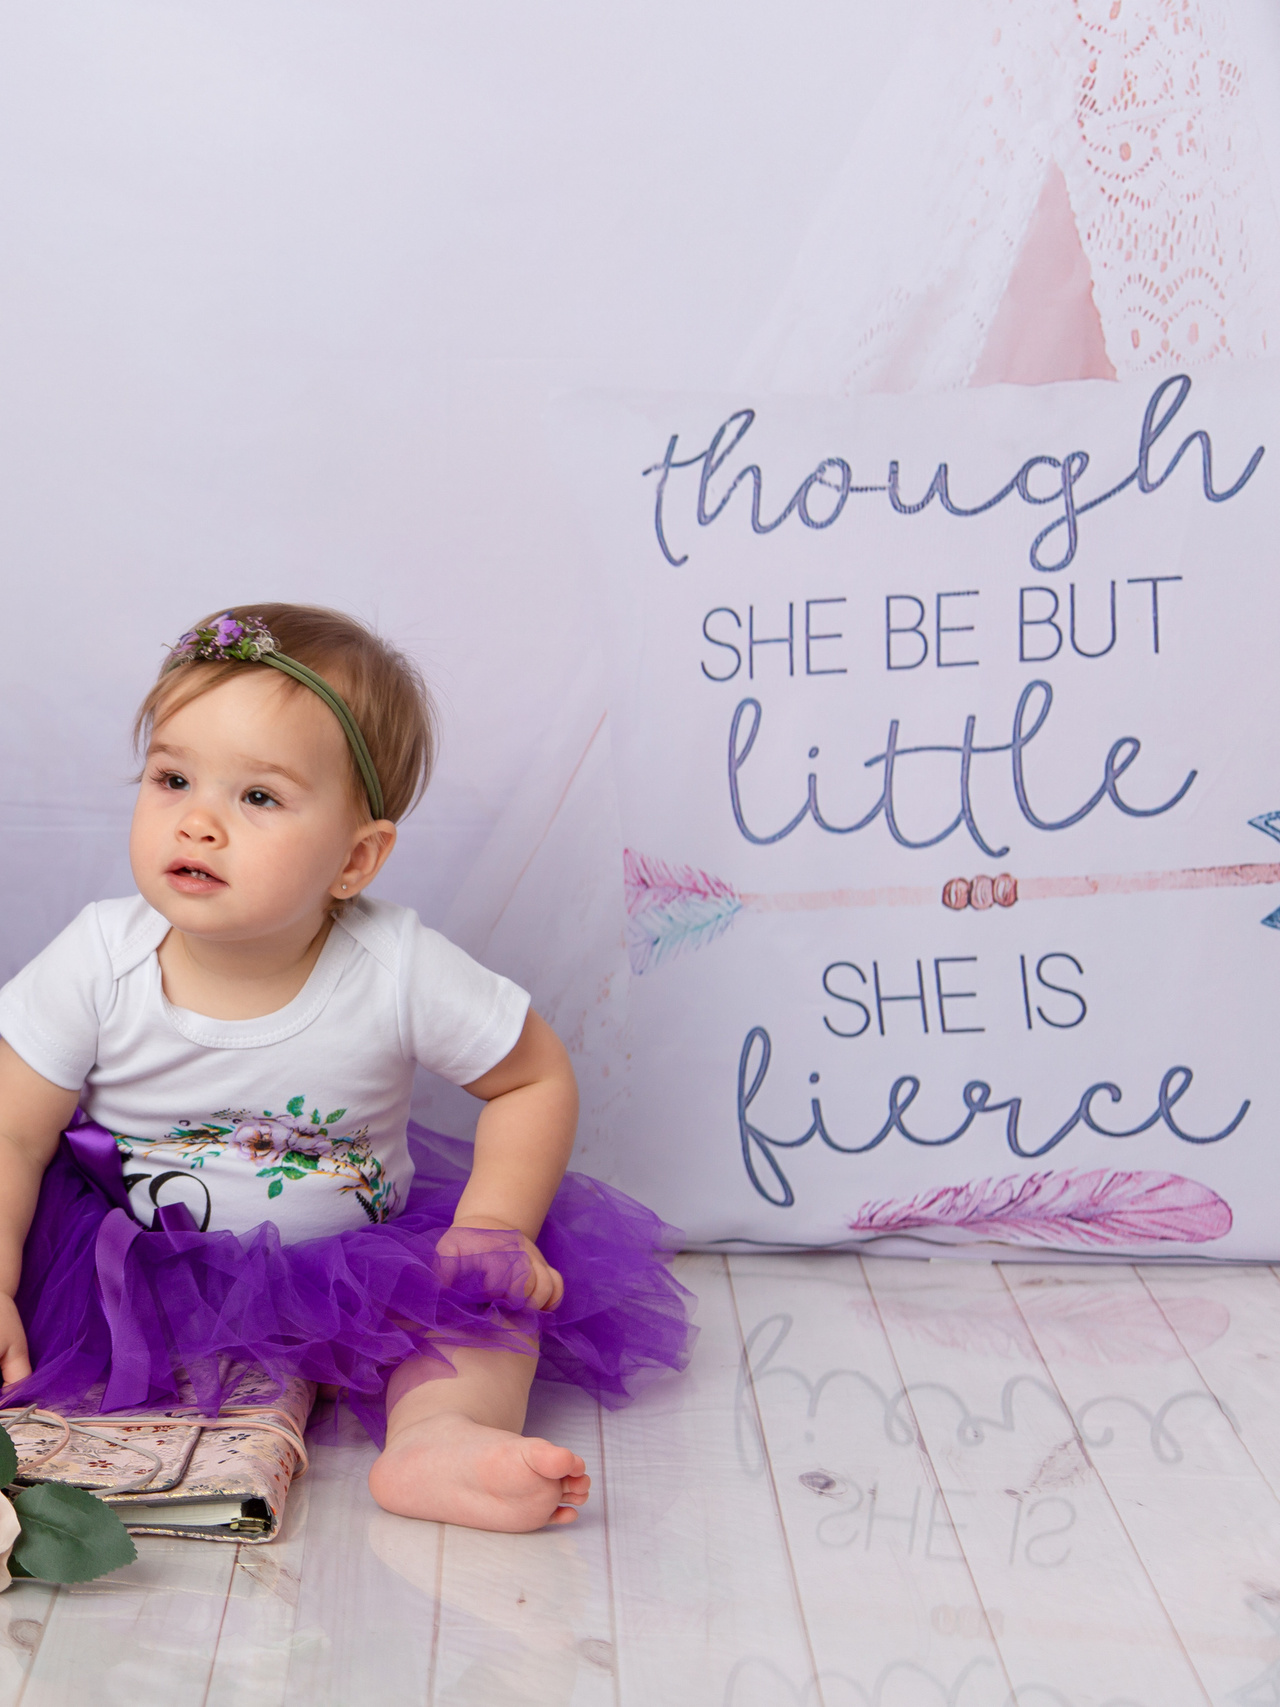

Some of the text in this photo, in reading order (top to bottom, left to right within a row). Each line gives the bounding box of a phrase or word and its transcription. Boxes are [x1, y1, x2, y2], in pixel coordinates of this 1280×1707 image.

[642, 373, 1266, 572] though
[700, 575, 1184, 682] SHE BE BUT
[728, 679, 1198, 858] little
[822, 952, 1088, 1038] SHE IS
[736, 1026, 1251, 1208] fierce
